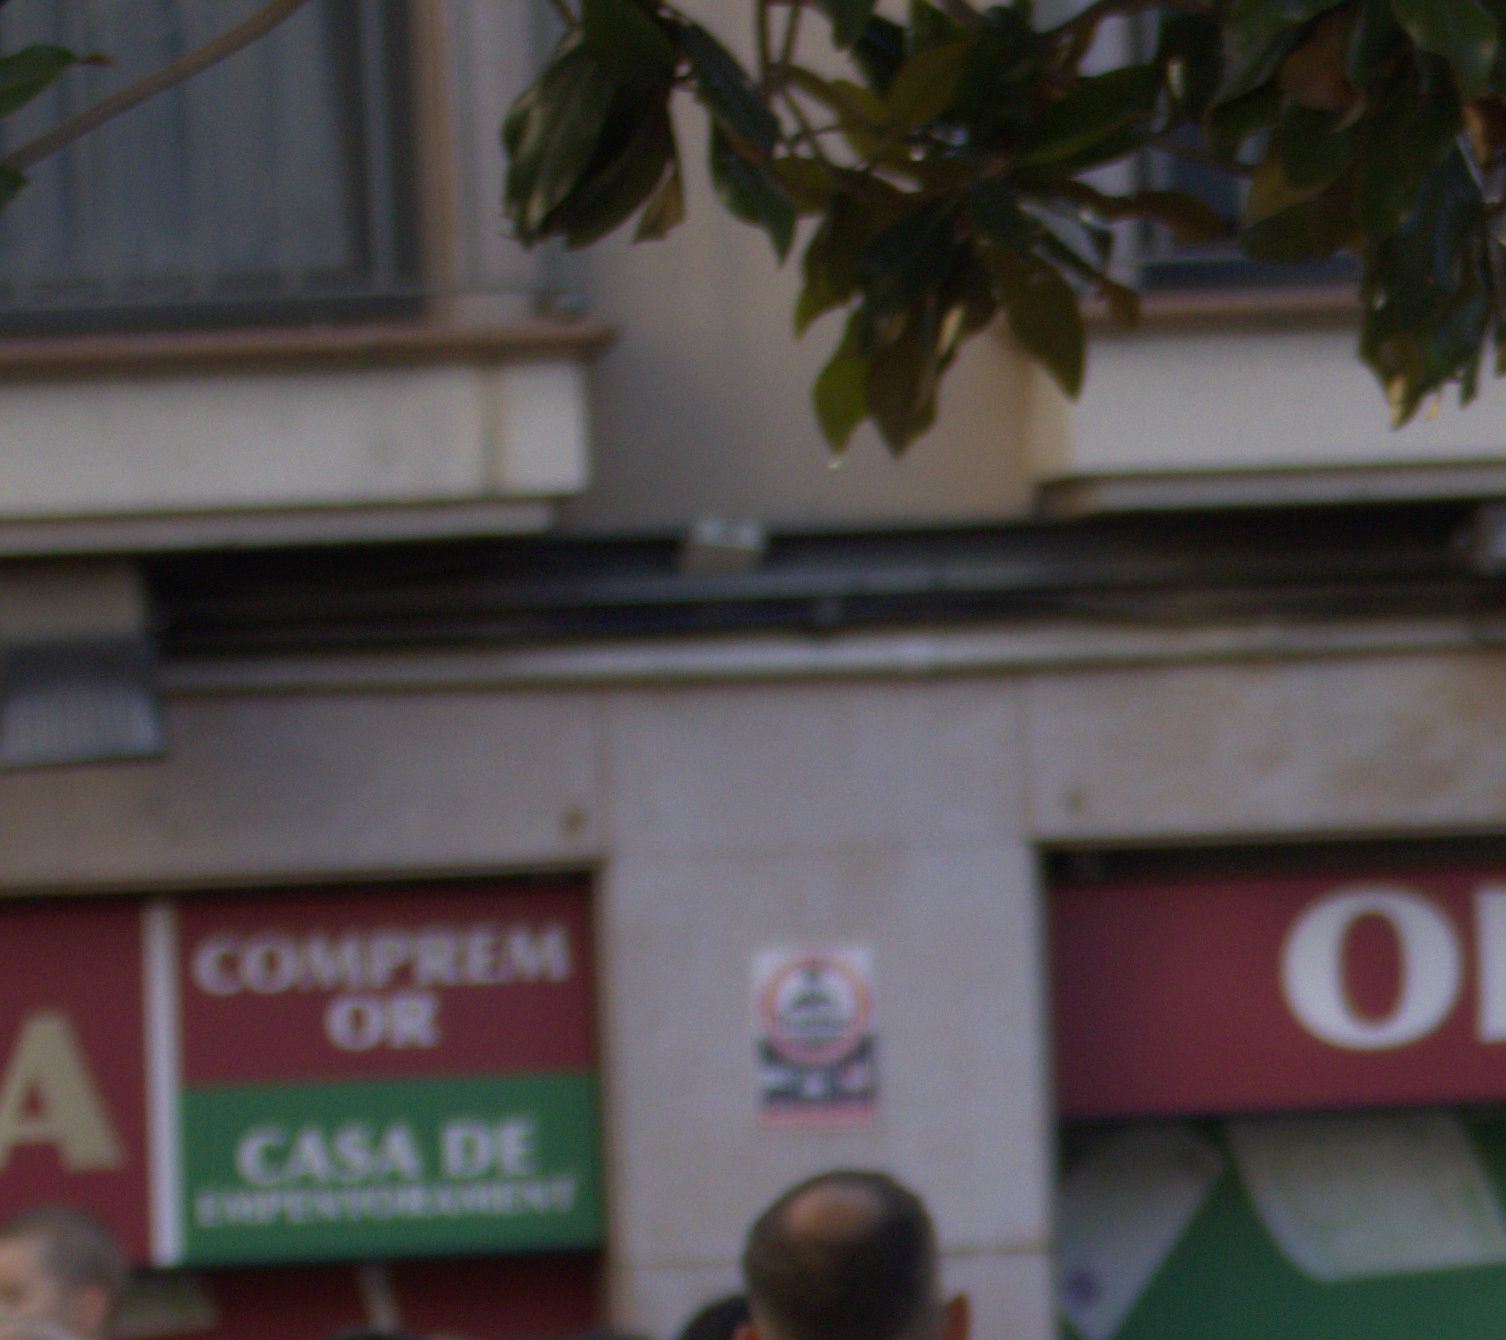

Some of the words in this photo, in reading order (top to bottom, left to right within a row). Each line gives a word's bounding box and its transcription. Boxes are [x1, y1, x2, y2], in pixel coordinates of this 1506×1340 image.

[193, 923, 570, 997] COMPREM
[326, 993, 438, 1052] OR
[236, 1120, 422, 1186] CASA
[442, 1118, 540, 1177] DE
